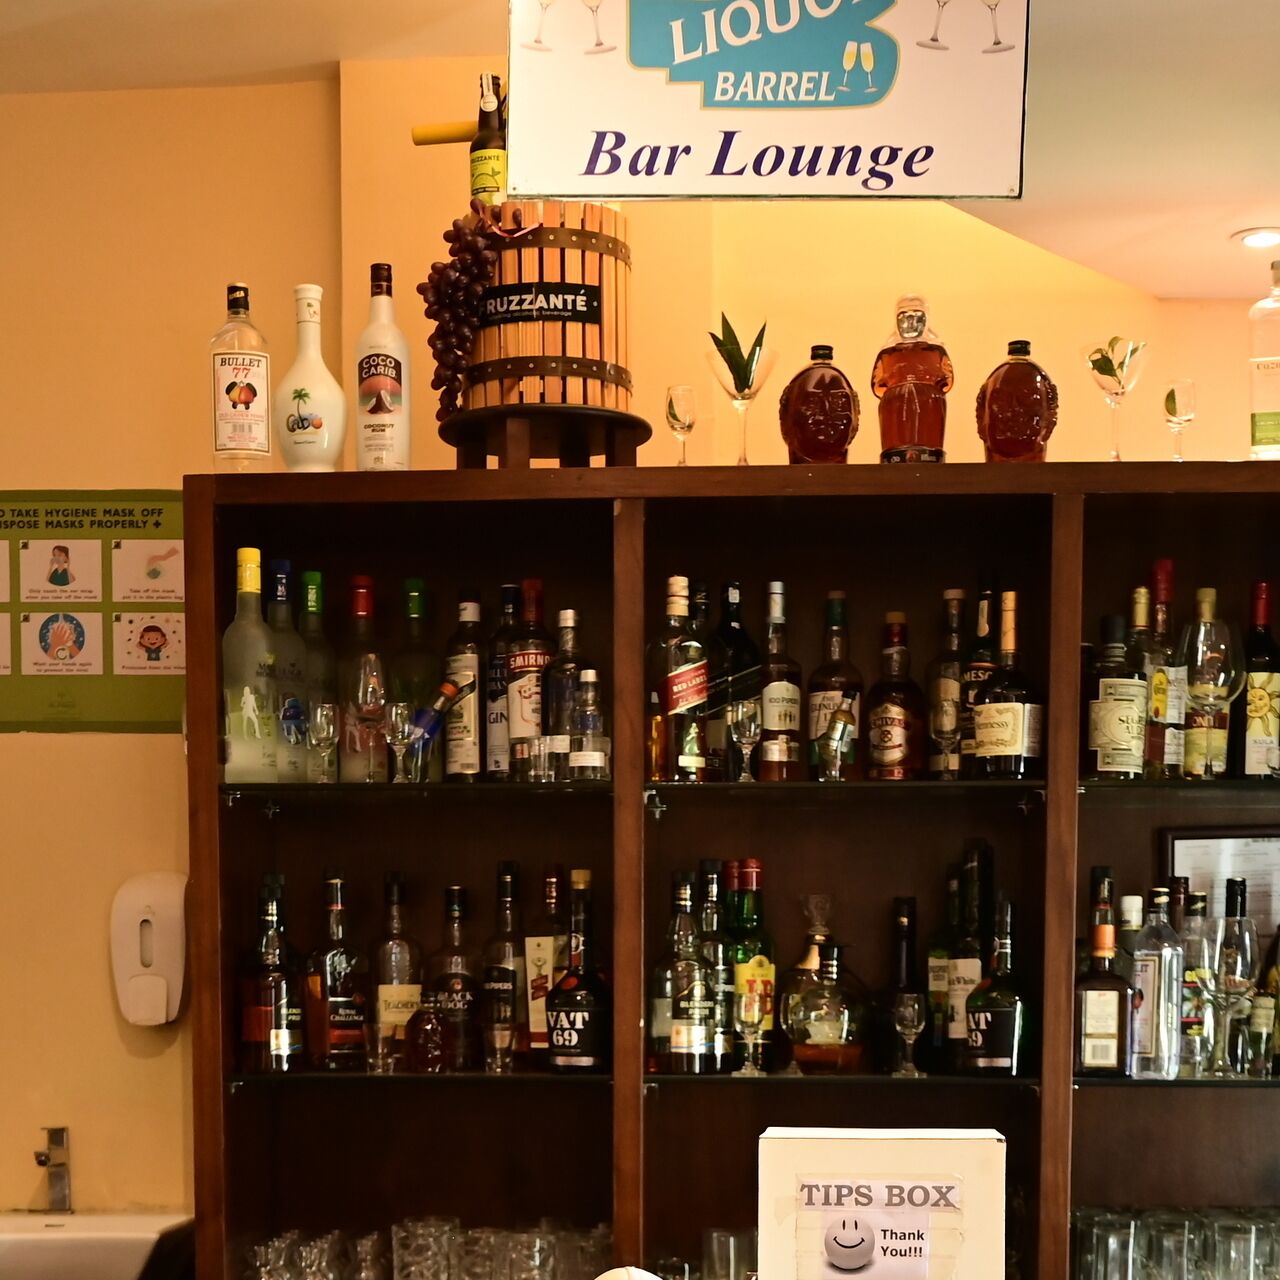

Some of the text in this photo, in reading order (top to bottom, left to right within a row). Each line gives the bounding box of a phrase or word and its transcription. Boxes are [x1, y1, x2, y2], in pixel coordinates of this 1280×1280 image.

[670, 0, 861, 64] LIQU
[714, 71, 836, 101] BARREL
[578, 130, 934, 190] Bar Lounge
[220, 357, 261, 368] BULLET
[362, 356, 395, 368] COCO
[232, 367, 250, 378] 77
[362, 365, 396, 378] CARIB
[10, 508, 39, 518] TAKE
[45, 508, 97, 518] HYGIENE
[103, 508, 135, 518] MASK
[141, 508, 164, 518] OFF
[45, 519, 84, 529] MASKS
[89, 519, 148, 529] PROPERLY
[488, 711, 508, 724] GIN
[548, 1011, 589, 1029] VAT
[552, 1029, 579, 1047] 69
[800, 1184, 956, 1208] TIPS BOX
[881, 1229, 925, 1241] Thank
[881, 1246, 923, 1258] You!!!
